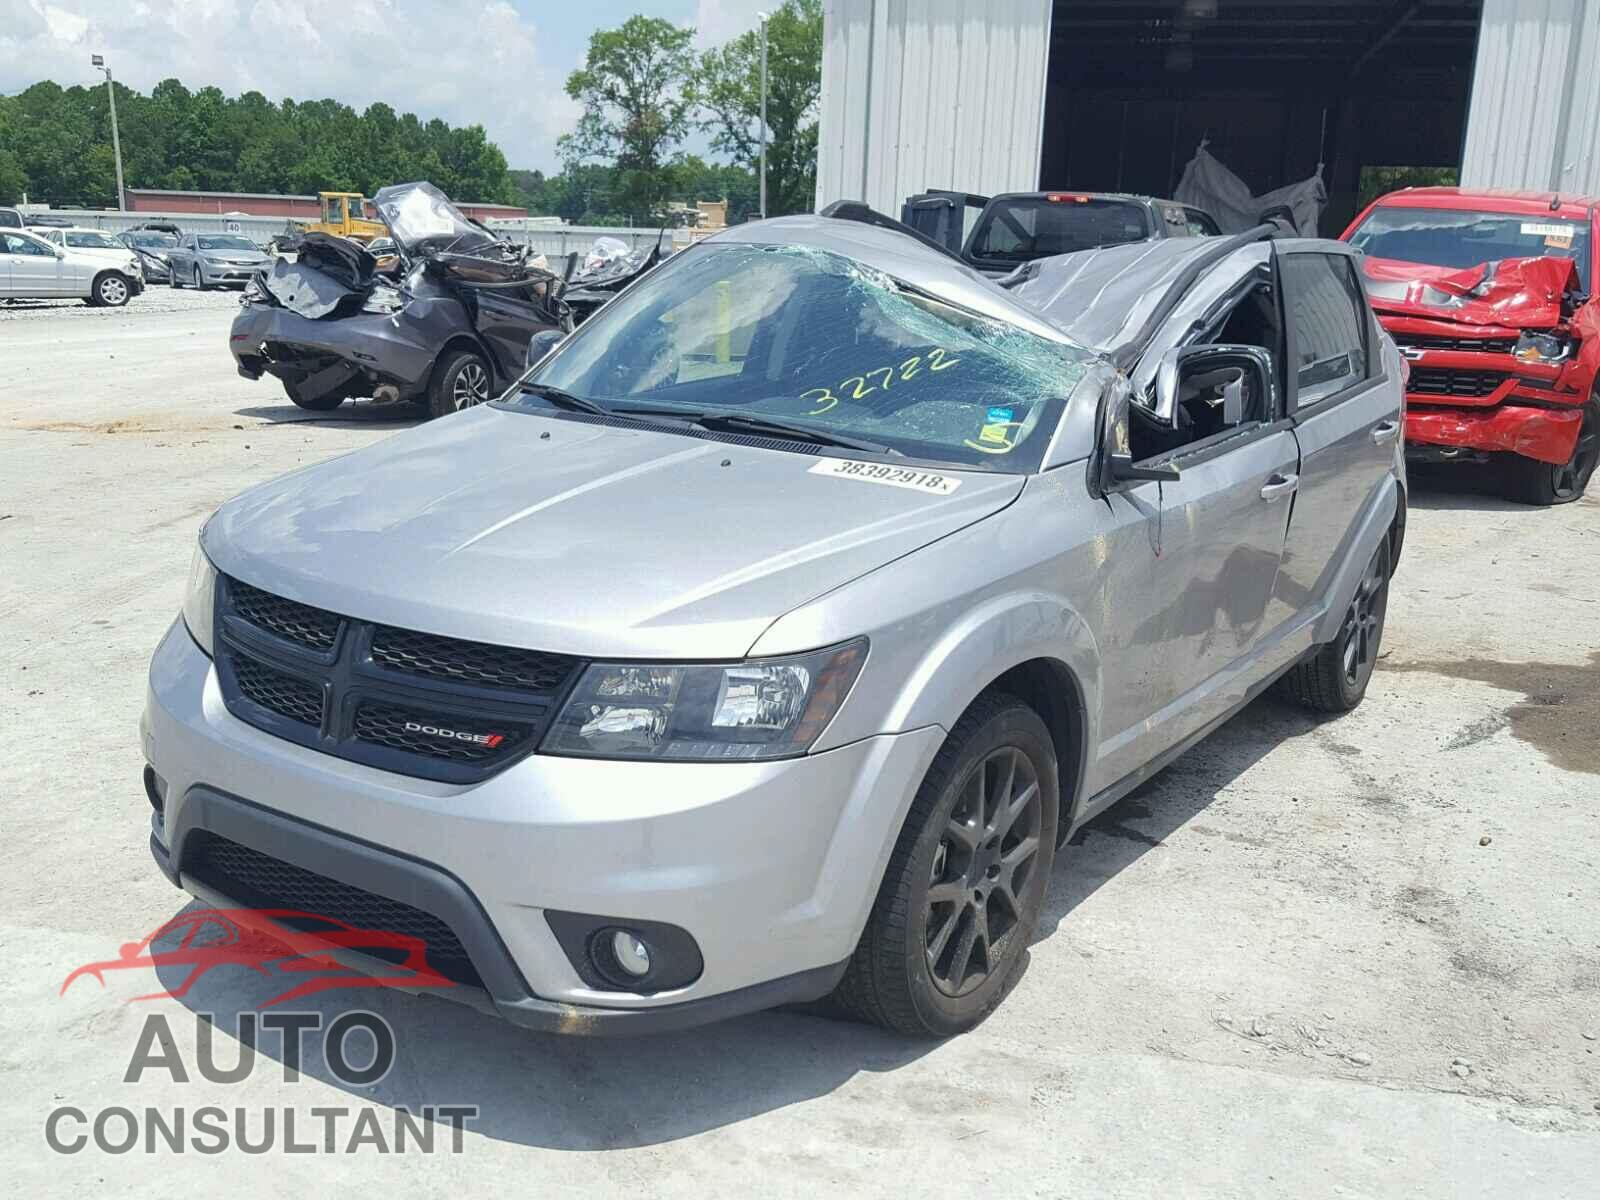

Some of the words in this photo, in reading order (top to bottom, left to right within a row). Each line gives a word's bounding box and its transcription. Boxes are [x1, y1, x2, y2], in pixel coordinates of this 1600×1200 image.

[229, 223, 240, 232] 40
[799, 348, 961, 416] 32722
[405, 721, 489, 744] DODGE
